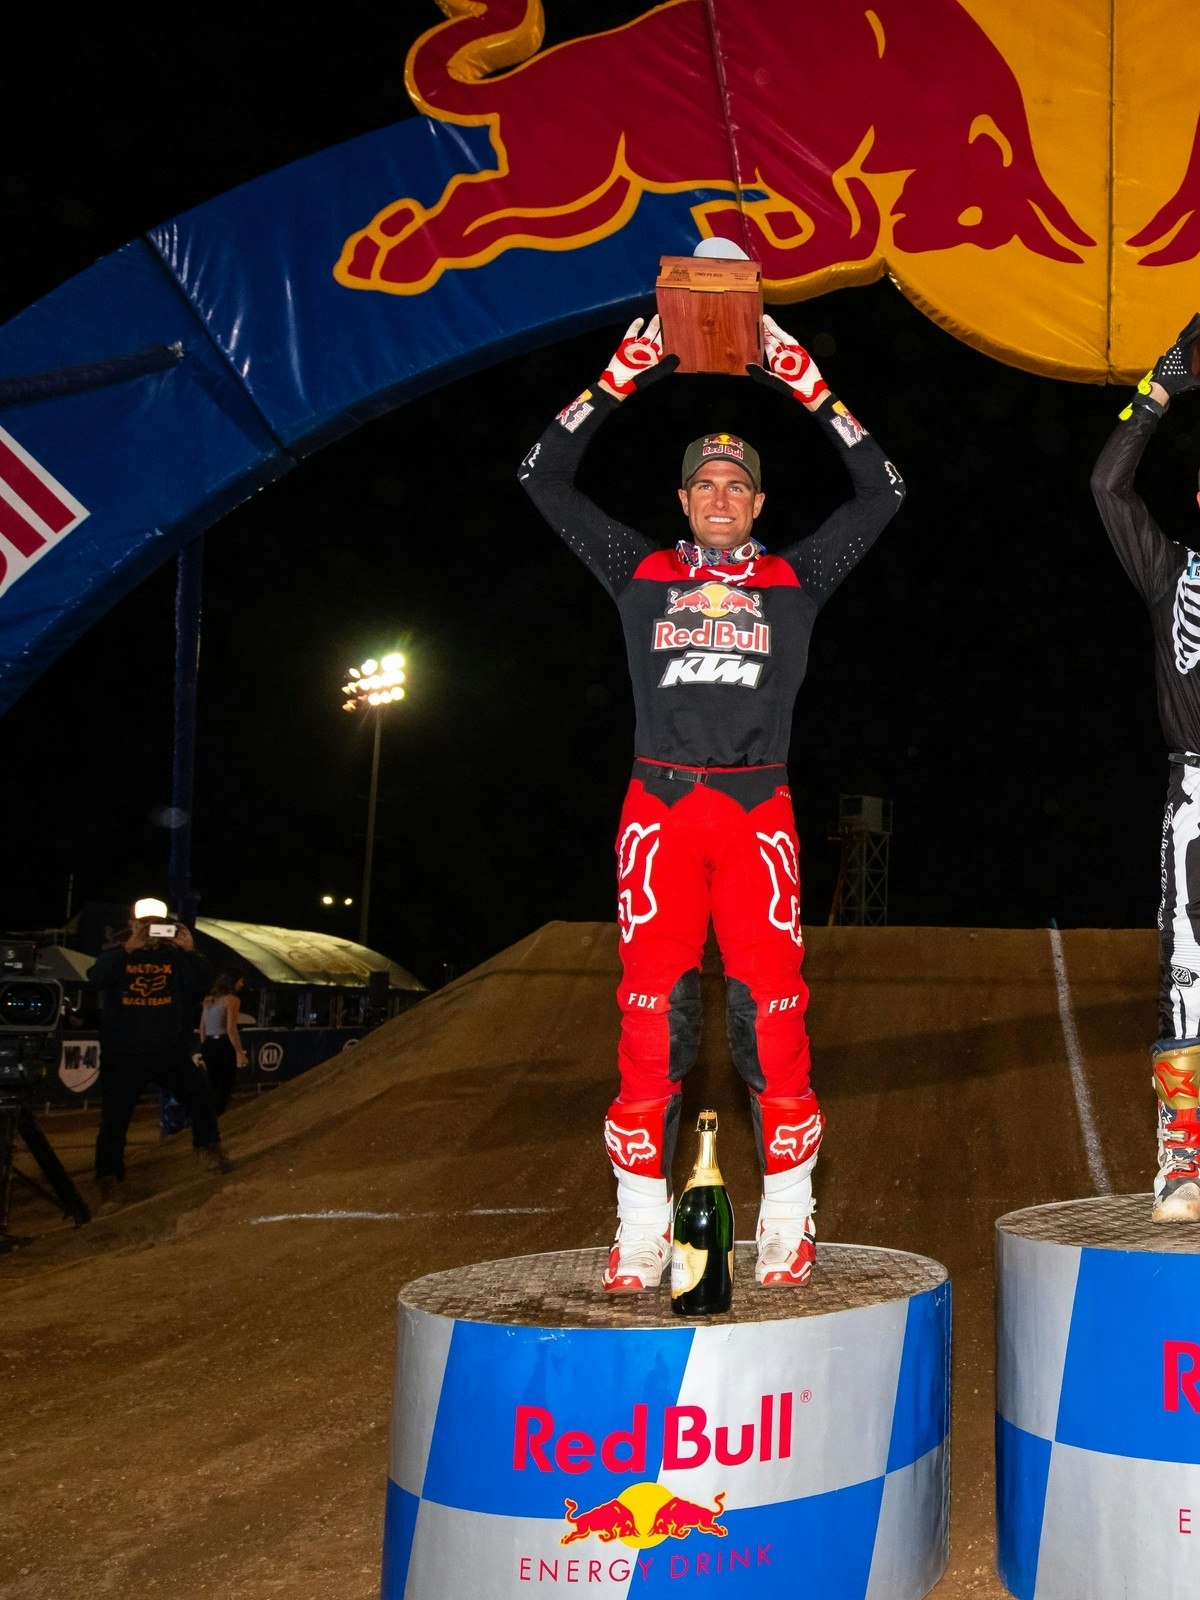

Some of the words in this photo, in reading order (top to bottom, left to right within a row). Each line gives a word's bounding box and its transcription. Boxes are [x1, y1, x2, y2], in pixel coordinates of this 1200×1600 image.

[565, 415, 581, 431] Red
[575, 402, 594, 420] Bull
[703, 445, 723, 456] Red
[724, 446, 744, 460] Bull
[0, 438, 77, 590] ll
[654, 620, 712, 651] Red
[714, 621, 769, 655] Bull
[660, 653, 762, 688] KTM
[127, 963, 172, 974] MOTO-X
[122, 997, 146, 1006] RACE
[148, 997, 172, 1006] TEAM
[628, 993, 658, 1009] FOX
[769, 994, 800, 1014] FOX
[64, 1045, 97, 1069] WD-40
[513, 1403, 648, 1474] Red
[663, 1392, 793, 1471] Bull
[519, 1556, 654, 1584] ENERGY
[670, 1543, 774, 1580] DRINK
